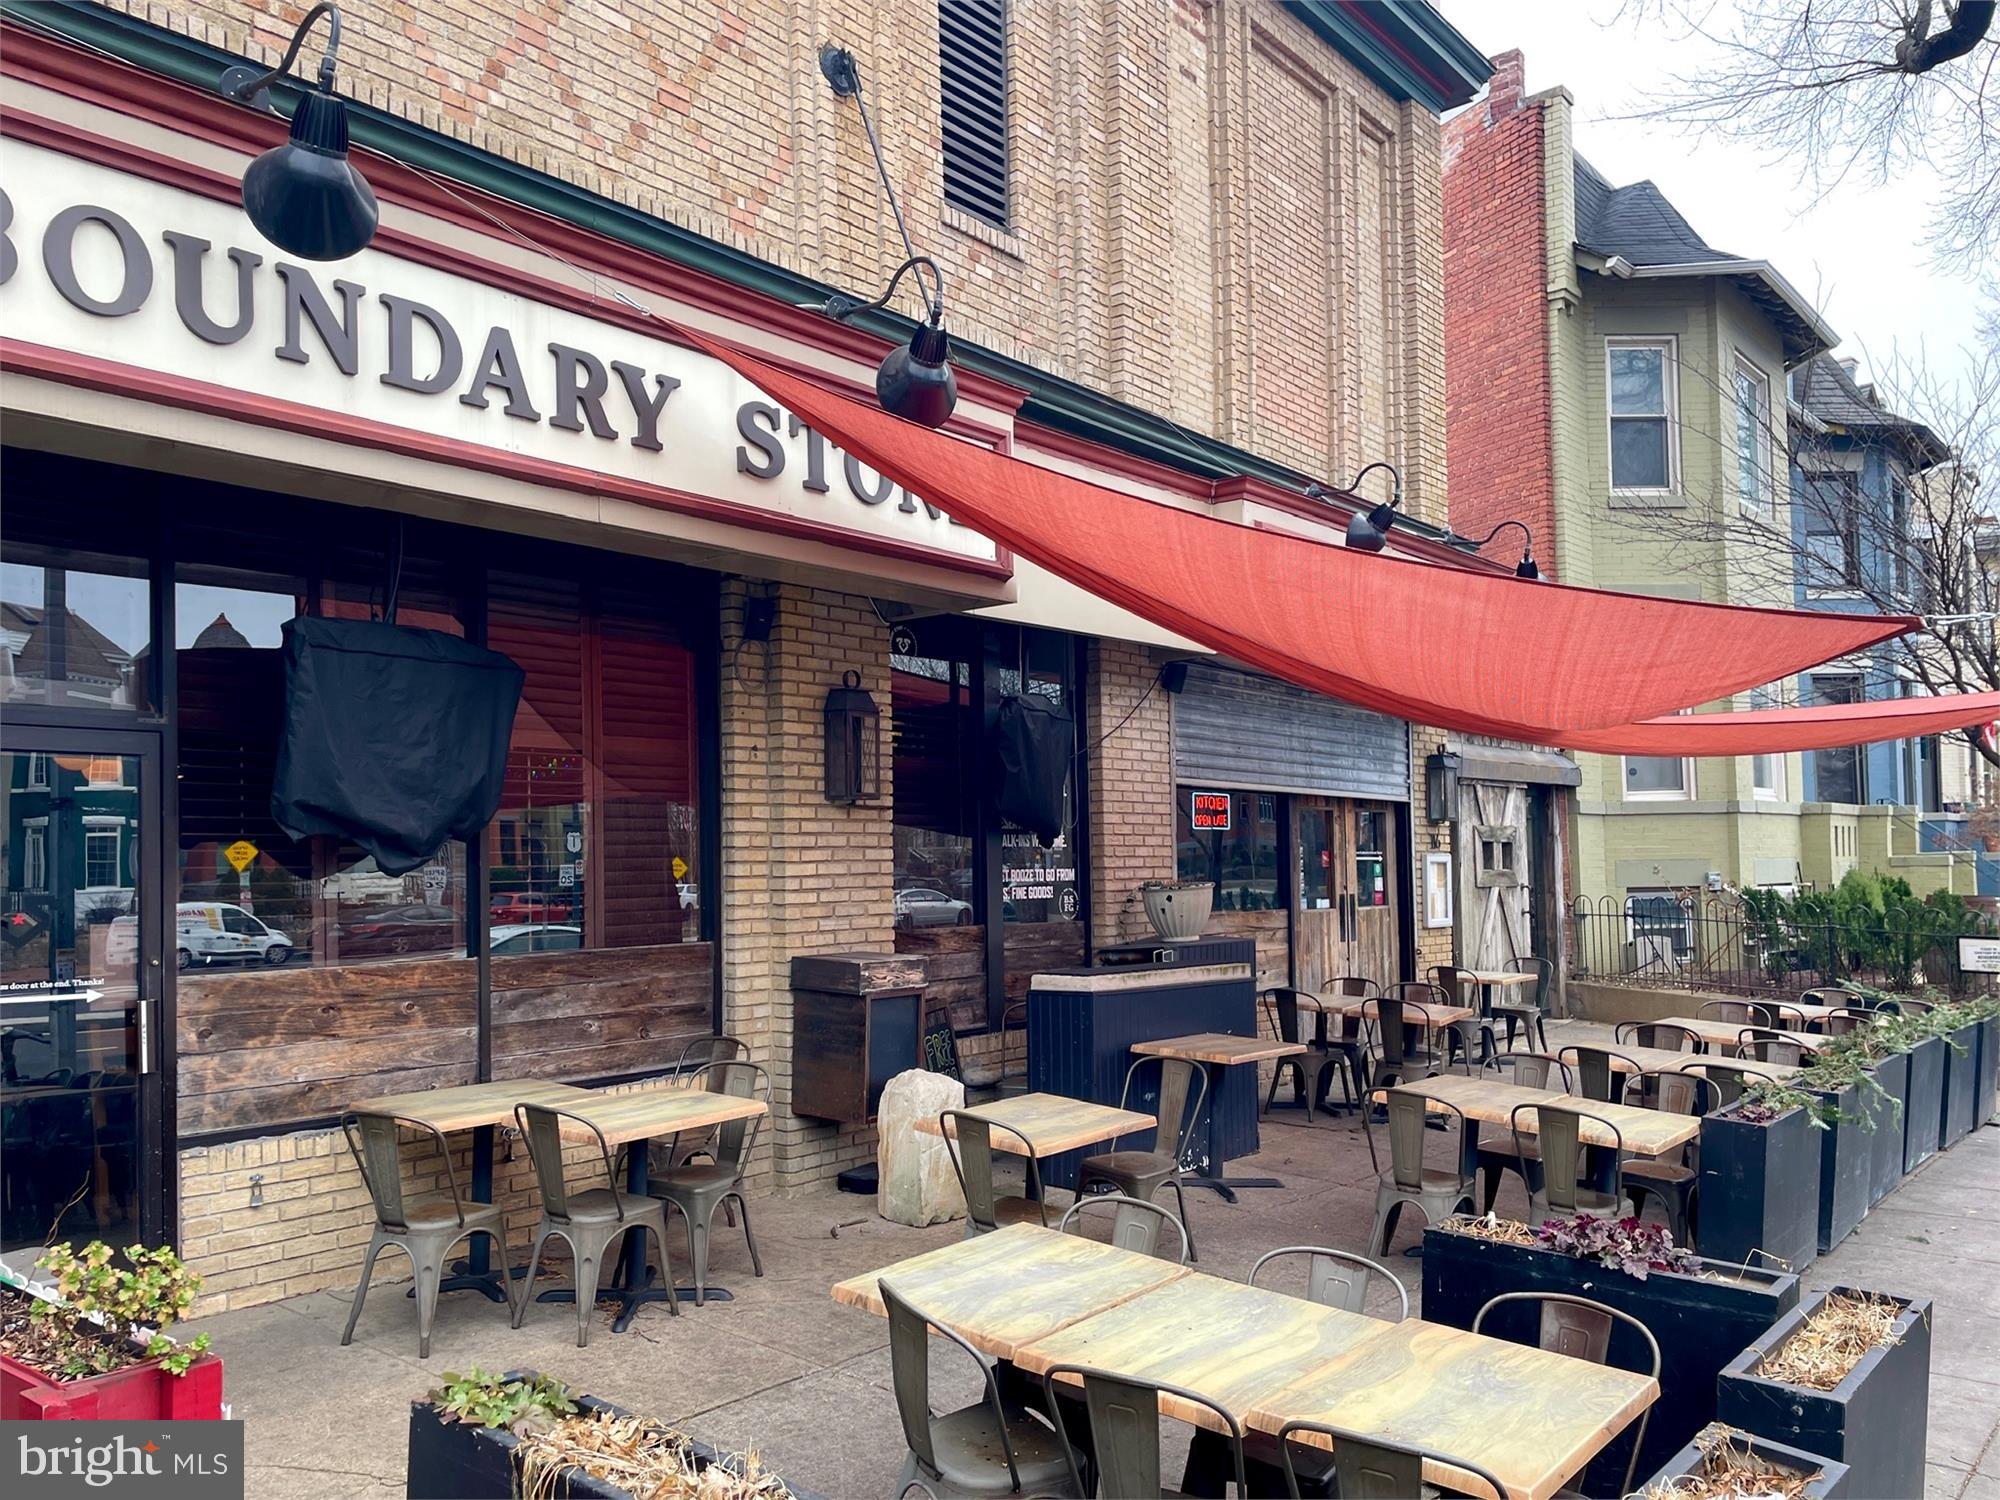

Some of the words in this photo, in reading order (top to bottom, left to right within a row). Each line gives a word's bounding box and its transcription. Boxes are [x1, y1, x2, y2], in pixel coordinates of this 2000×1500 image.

[0, 186, 682, 452] OUNDARY
[736, 401, 965, 525] STO
[1196, 796, 1228, 810] KITCHEN
[1195, 814, 1211, 826] OPEN
[1213, 814, 1227, 826] LATE
[1011, 869, 1034, 882] BOOZE
[1035, 869, 1044, 881] TO
[1045, 869, 1055, 881] GO
[1056, 868, 1075, 881] FROM
[1012, 887, 1027, 899] FINE
[1028, 886, 1053, 899] GOODS!
[9, 981, 29, 990] door
[30, 981, 39, 989] at
[39, 980, 53, 989] the
[54, 979, 71, 988] end.
[72, 978, 105, 987] Thanks!
